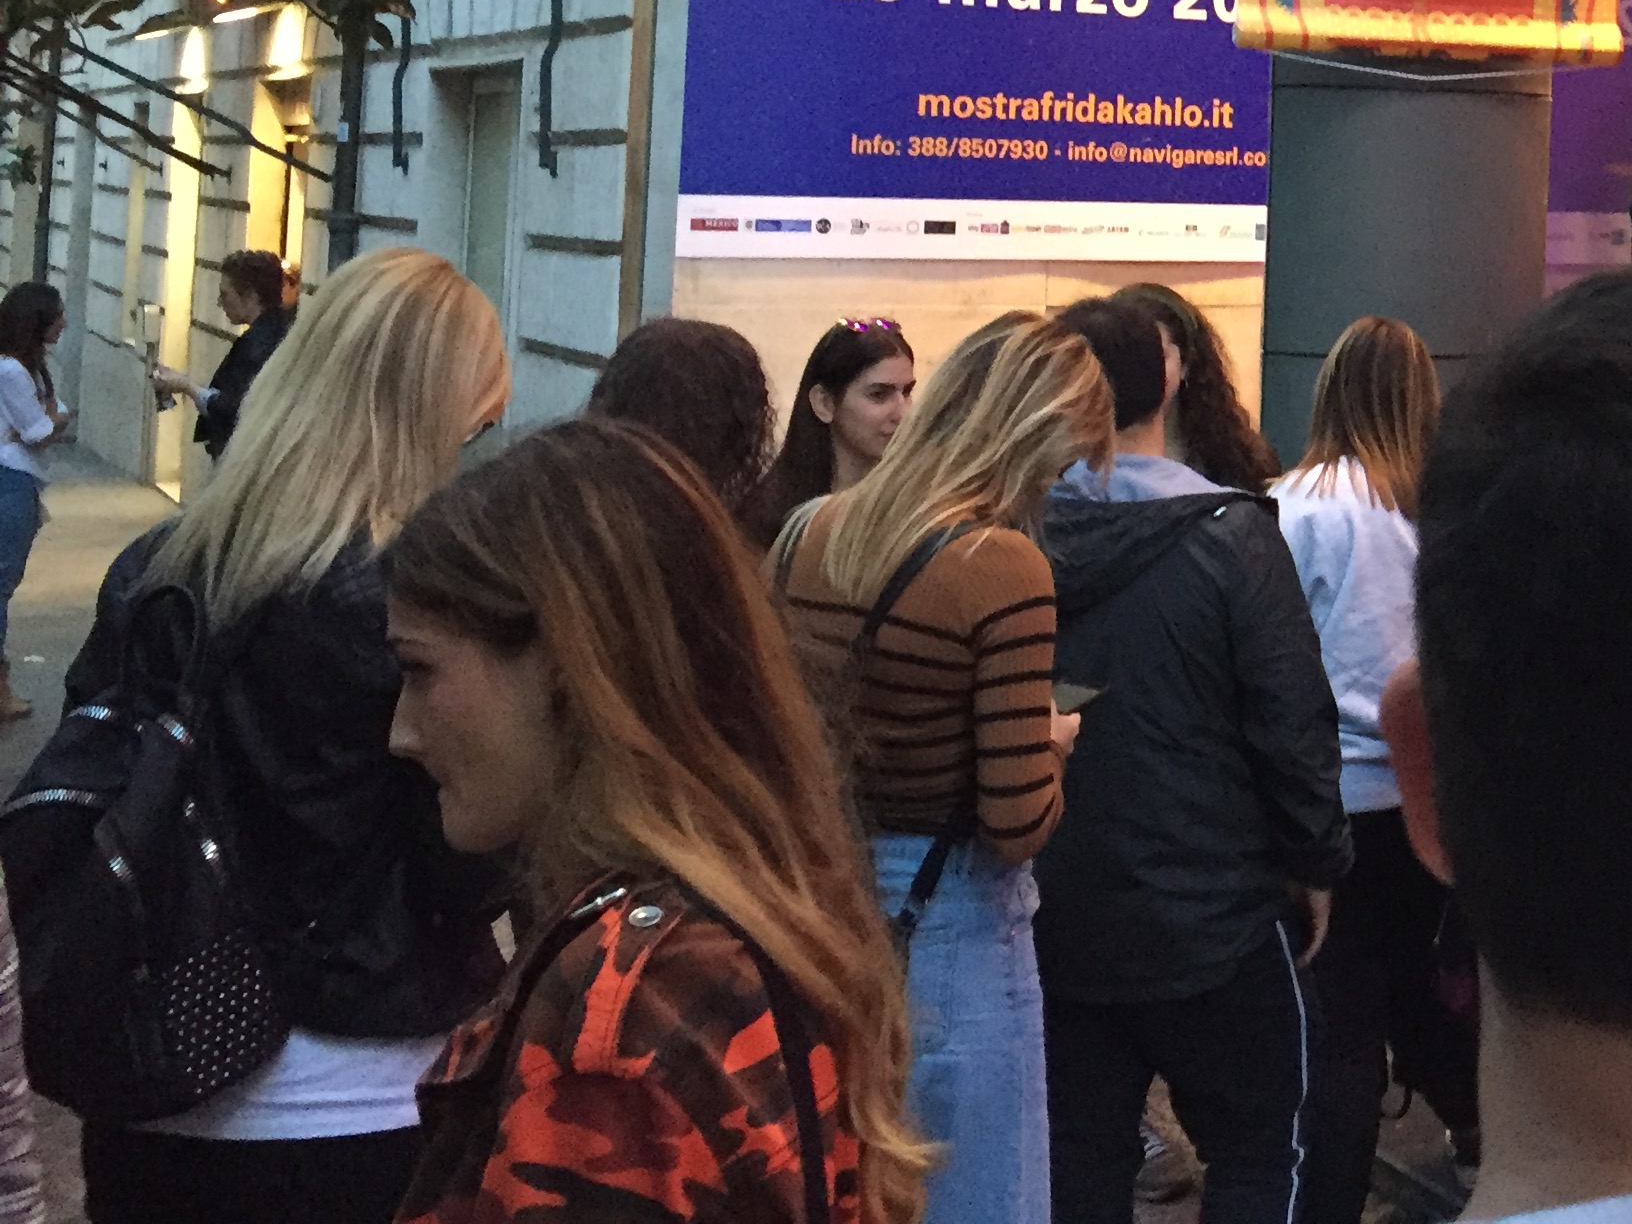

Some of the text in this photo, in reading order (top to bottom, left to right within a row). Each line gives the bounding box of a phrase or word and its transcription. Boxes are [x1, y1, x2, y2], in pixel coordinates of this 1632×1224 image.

[918, 91, 1233, 129] mostrafridakahlo.it
[851, 133, 902, 157] Info:
[907, 136, 1048, 160] 388/8507930
